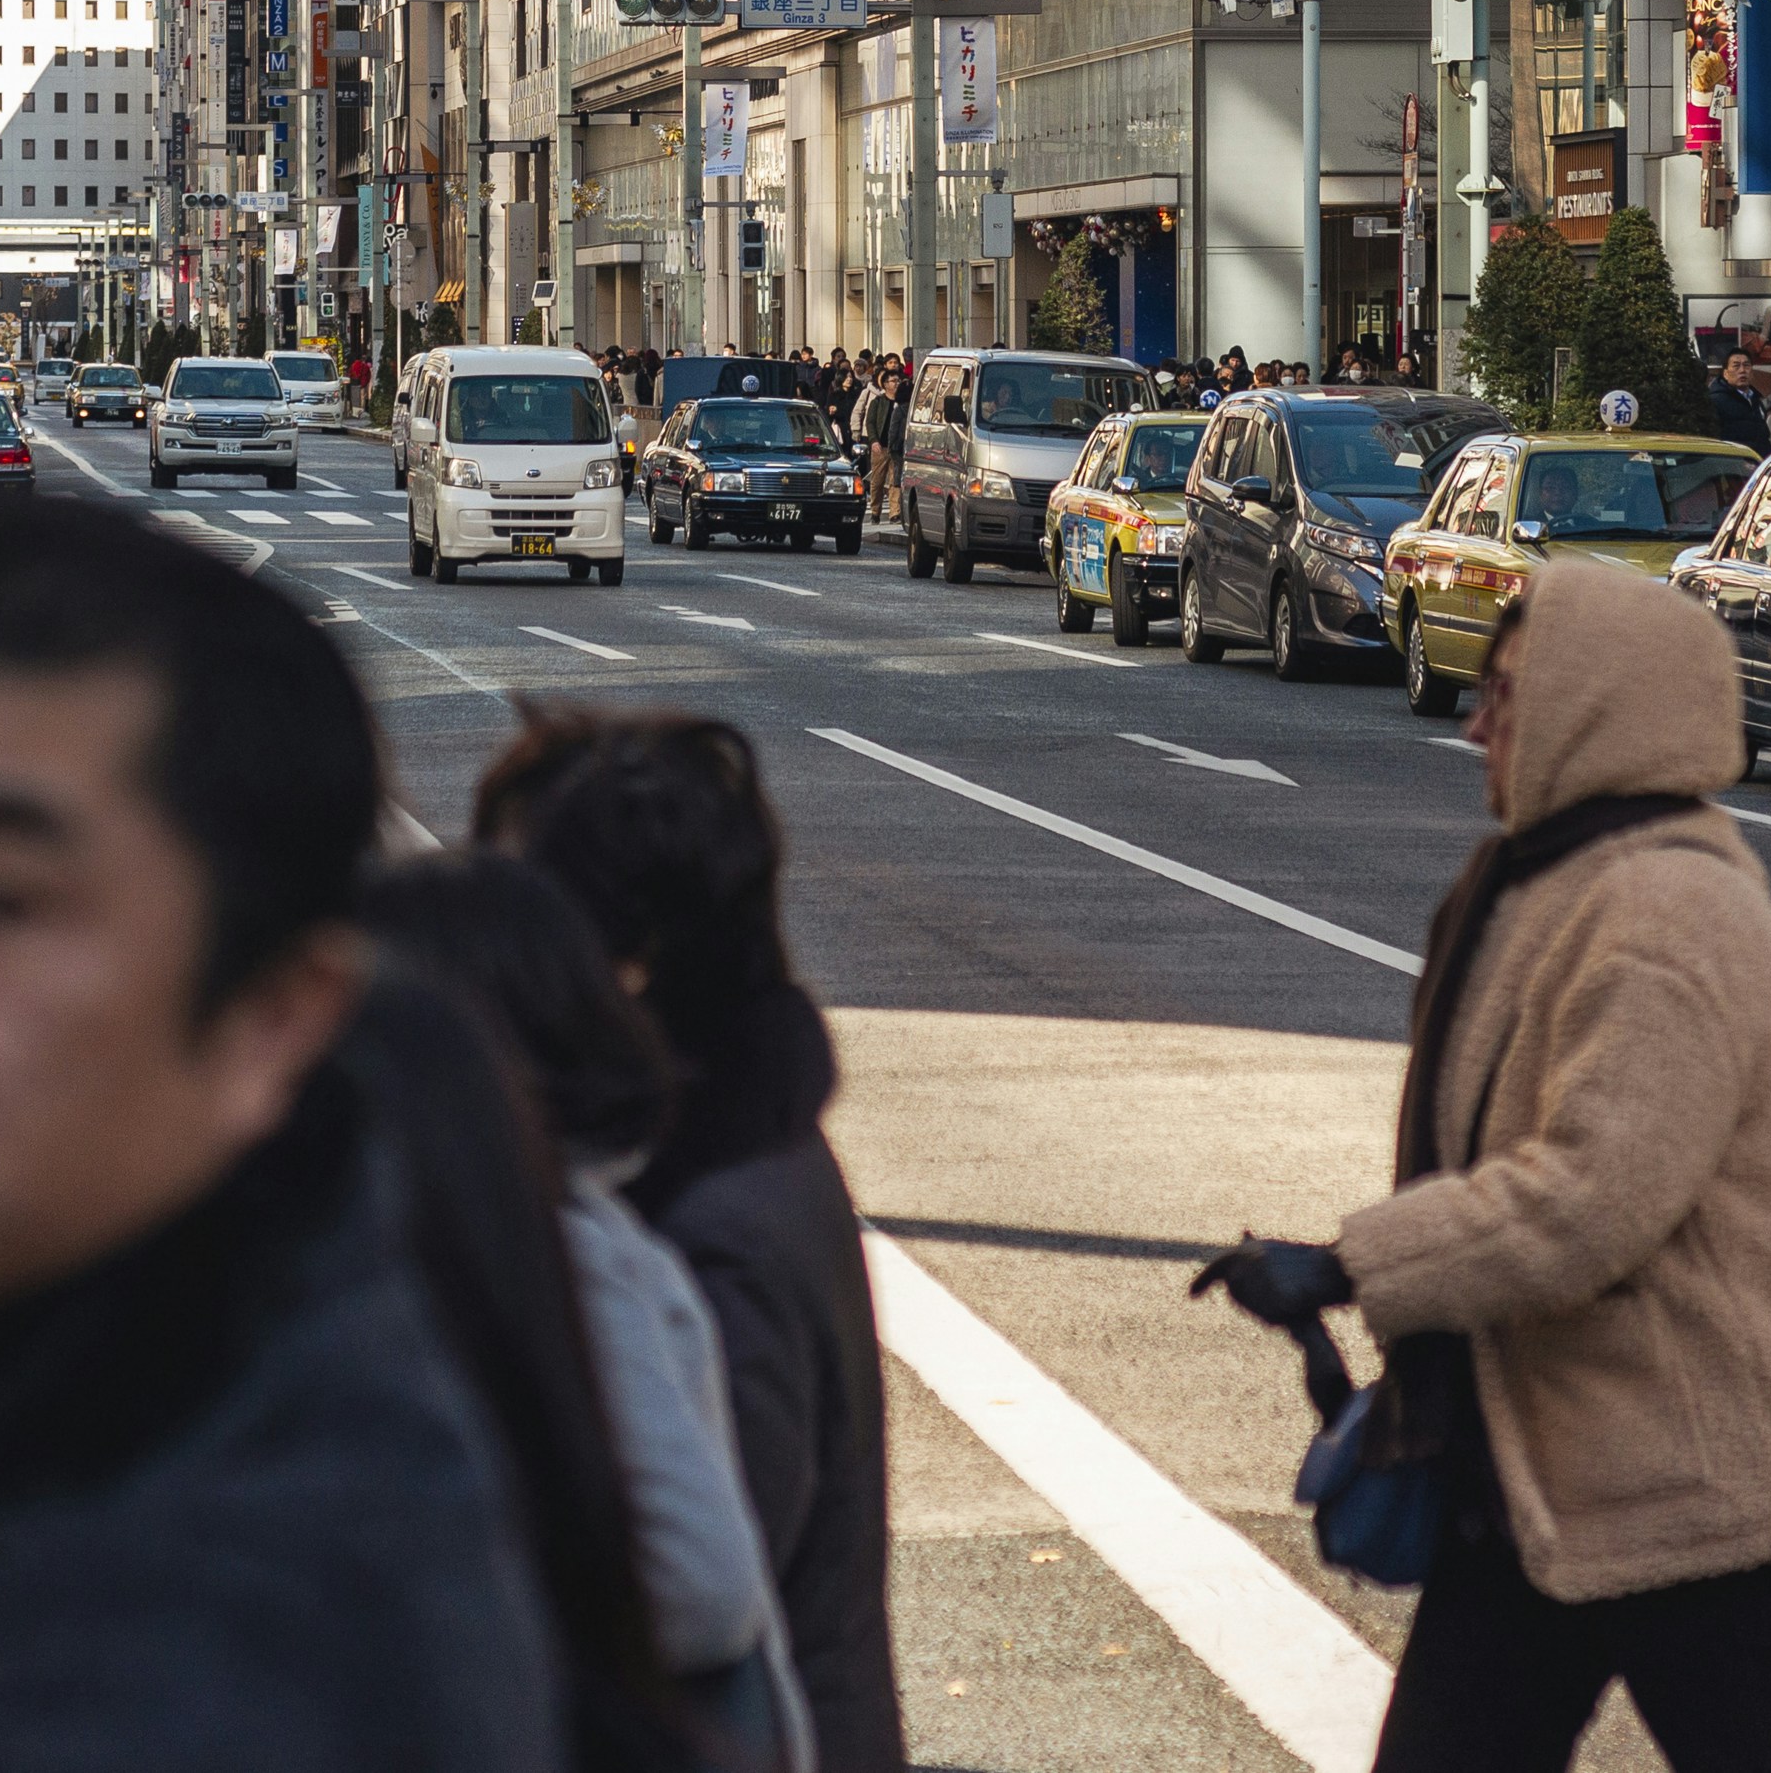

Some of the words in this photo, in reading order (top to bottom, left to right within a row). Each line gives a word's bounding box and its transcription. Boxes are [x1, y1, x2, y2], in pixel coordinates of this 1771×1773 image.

[783, 12, 814, 25] Ginza
[818, 13, 826, 24] 3
[960, 26, 978, 122] ヒカリミチ
[719, 87, 734, 161] ヒカリミチ
[361, 231, 371, 269] TIFFANY
[1614, 394, 1632, 424] 大和
[522, 542, 553, 556] 18-64
